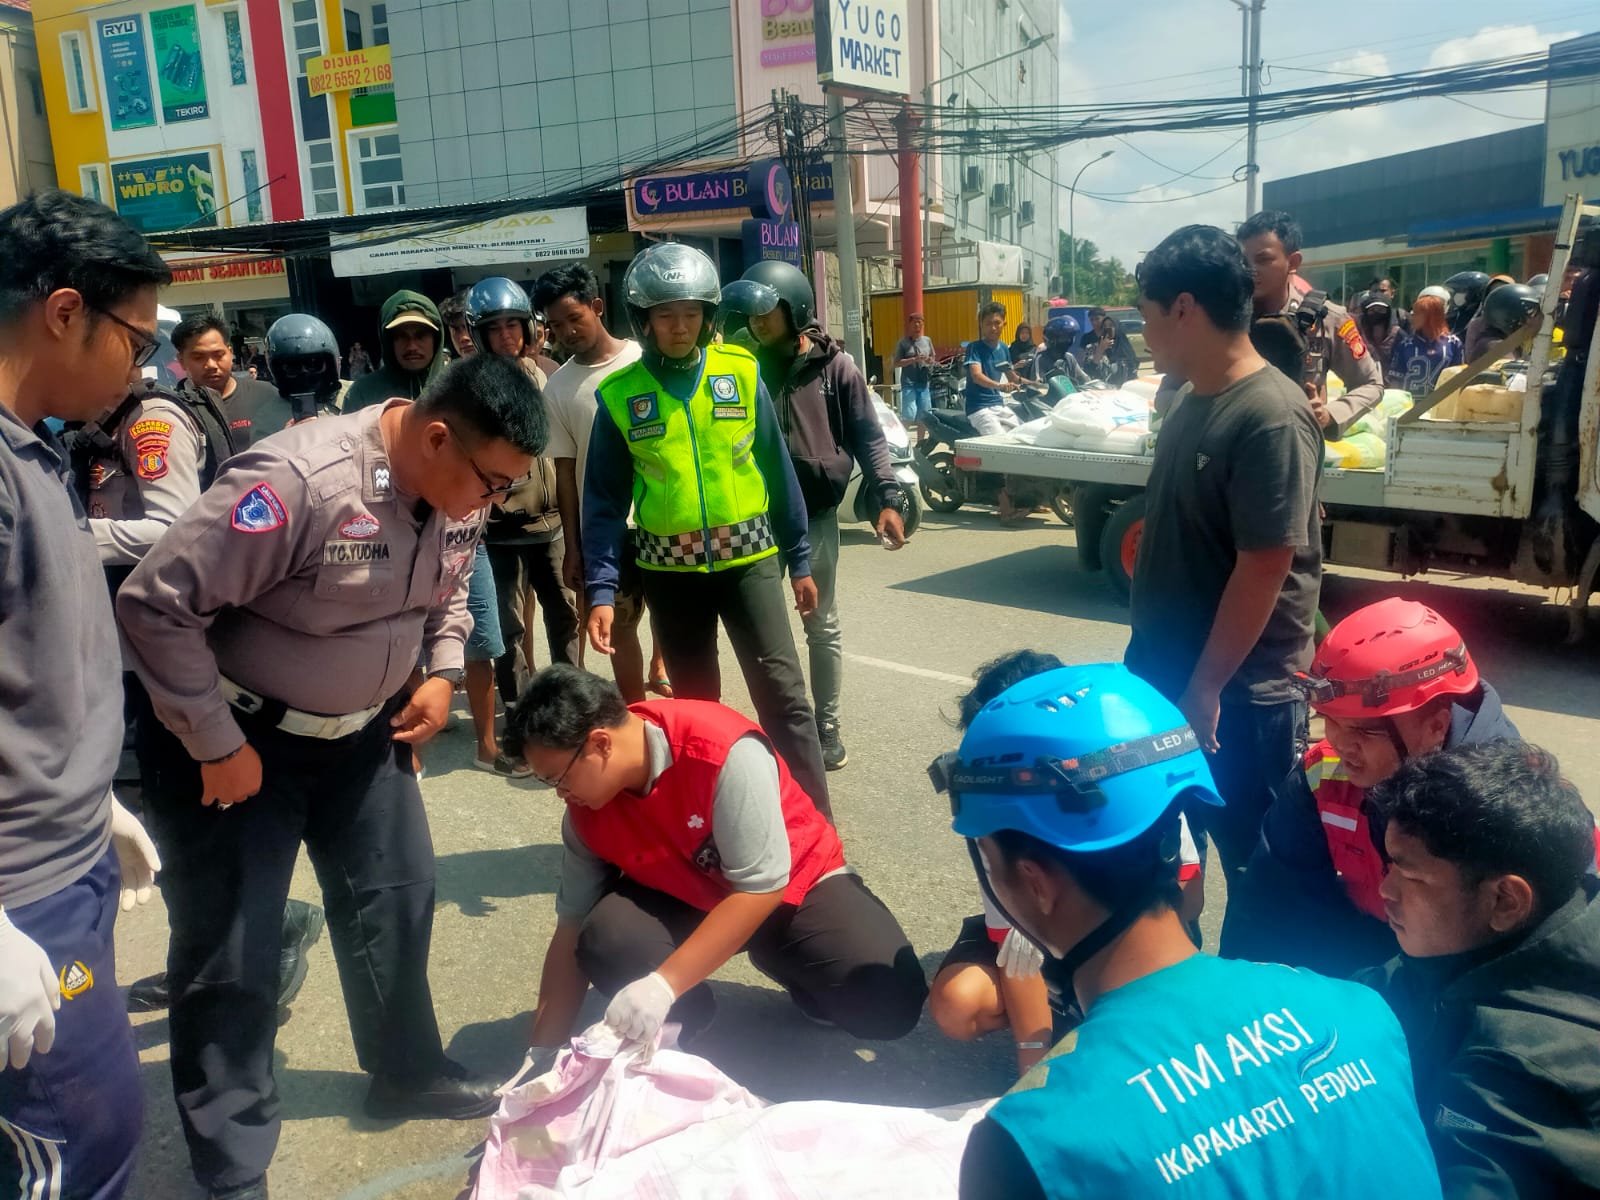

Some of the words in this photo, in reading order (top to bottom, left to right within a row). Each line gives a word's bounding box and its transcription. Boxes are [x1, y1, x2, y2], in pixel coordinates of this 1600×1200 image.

[104, 21, 134, 36] RYU
[838, 0, 901, 42] YUGO
[323, 53, 368, 70] DIJUAL
[839, 36, 902, 79] MARKET
[363, 63, 392, 84] 2168
[175, 105, 205, 118] TEKIRO
[119, 178, 185, 200] WIPRO
[665, 178, 729, 203] BULAN
[761, 222, 799, 248] BULAN
[1416, 668, 1436, 680] LED
[1152, 734, 1182, 752] LED
[1126, 1043, 1226, 1114] TIM
[1225, 1007, 1314, 1077] AKSI
[1154, 1096, 1295, 1185] IKAPAKARTI
[1299, 1058, 1377, 1114] PEDULI
